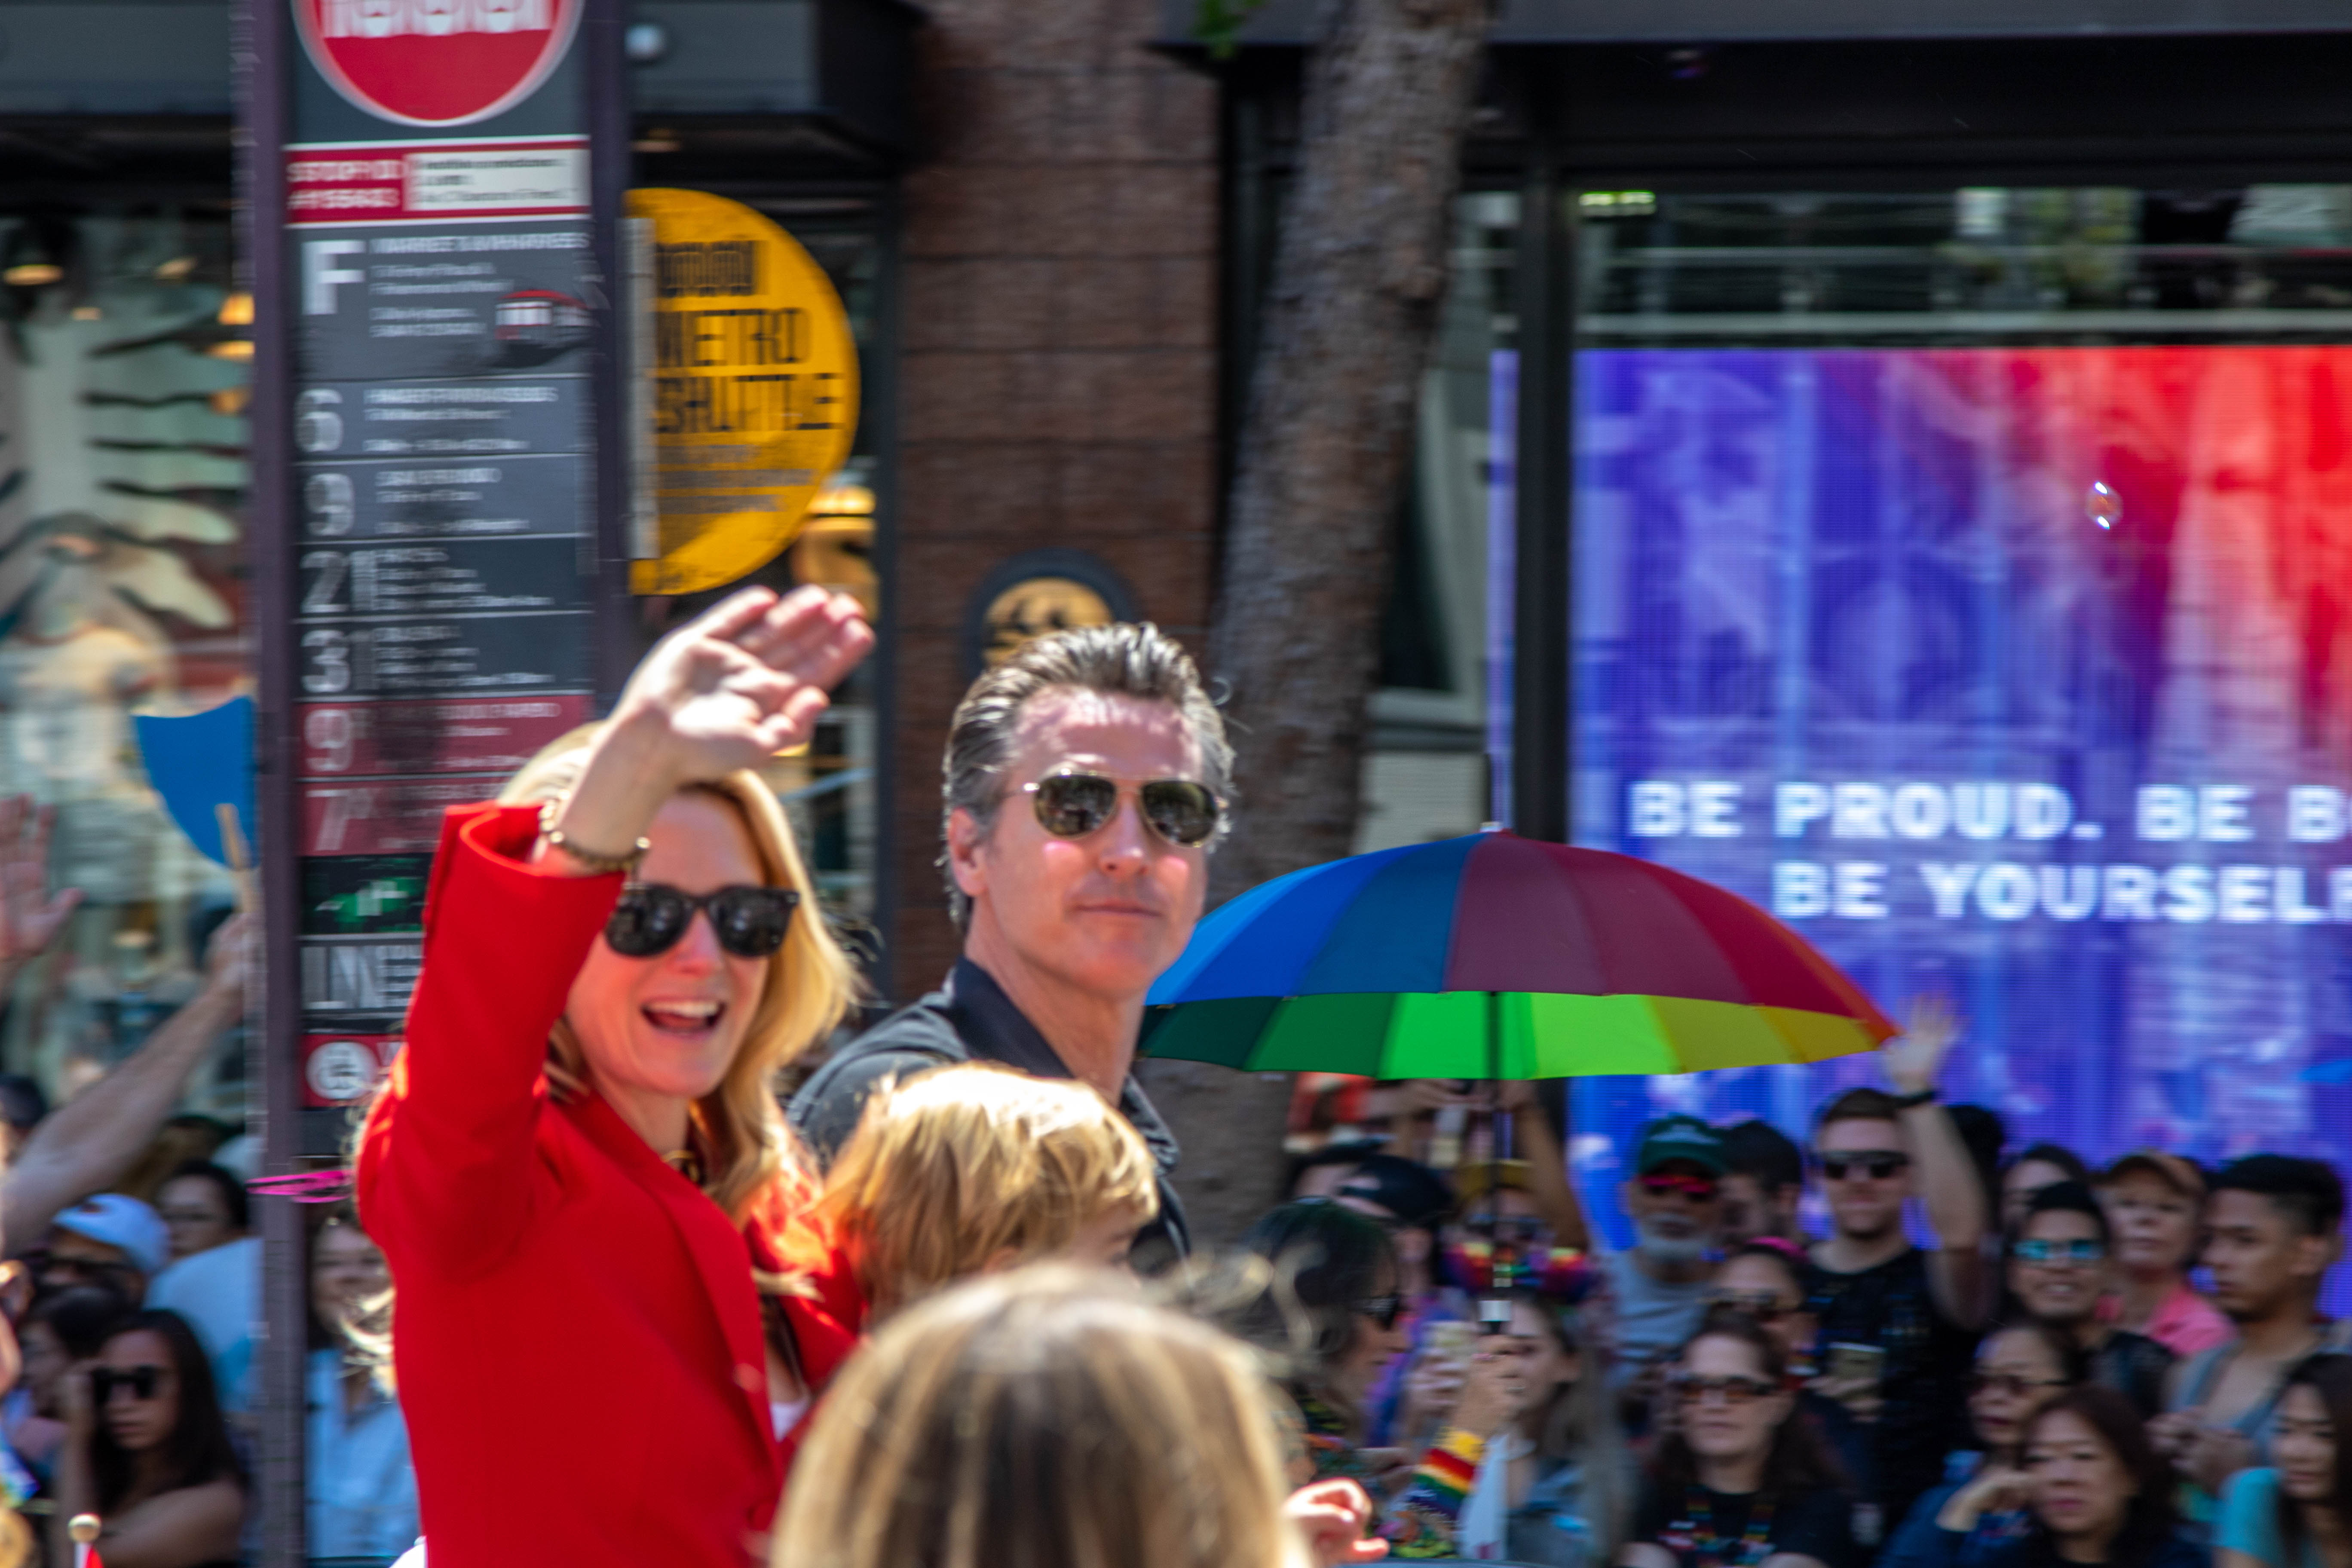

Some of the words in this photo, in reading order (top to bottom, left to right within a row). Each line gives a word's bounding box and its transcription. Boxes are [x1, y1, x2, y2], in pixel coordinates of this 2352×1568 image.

[302, 240, 365, 315] F
[295, 388, 343, 452] 6
[305, 473, 355, 536] 9
[300, 550, 380, 613] 21
[300, 629, 380, 693] 31
[1630, 781, 1744, 837] BE
[1772, 782, 2105, 841] PROUD.
[2135, 784, 2256, 842] BE
[2287, 784, 2352, 843] B
[1772, 862, 1889, 919] BE
